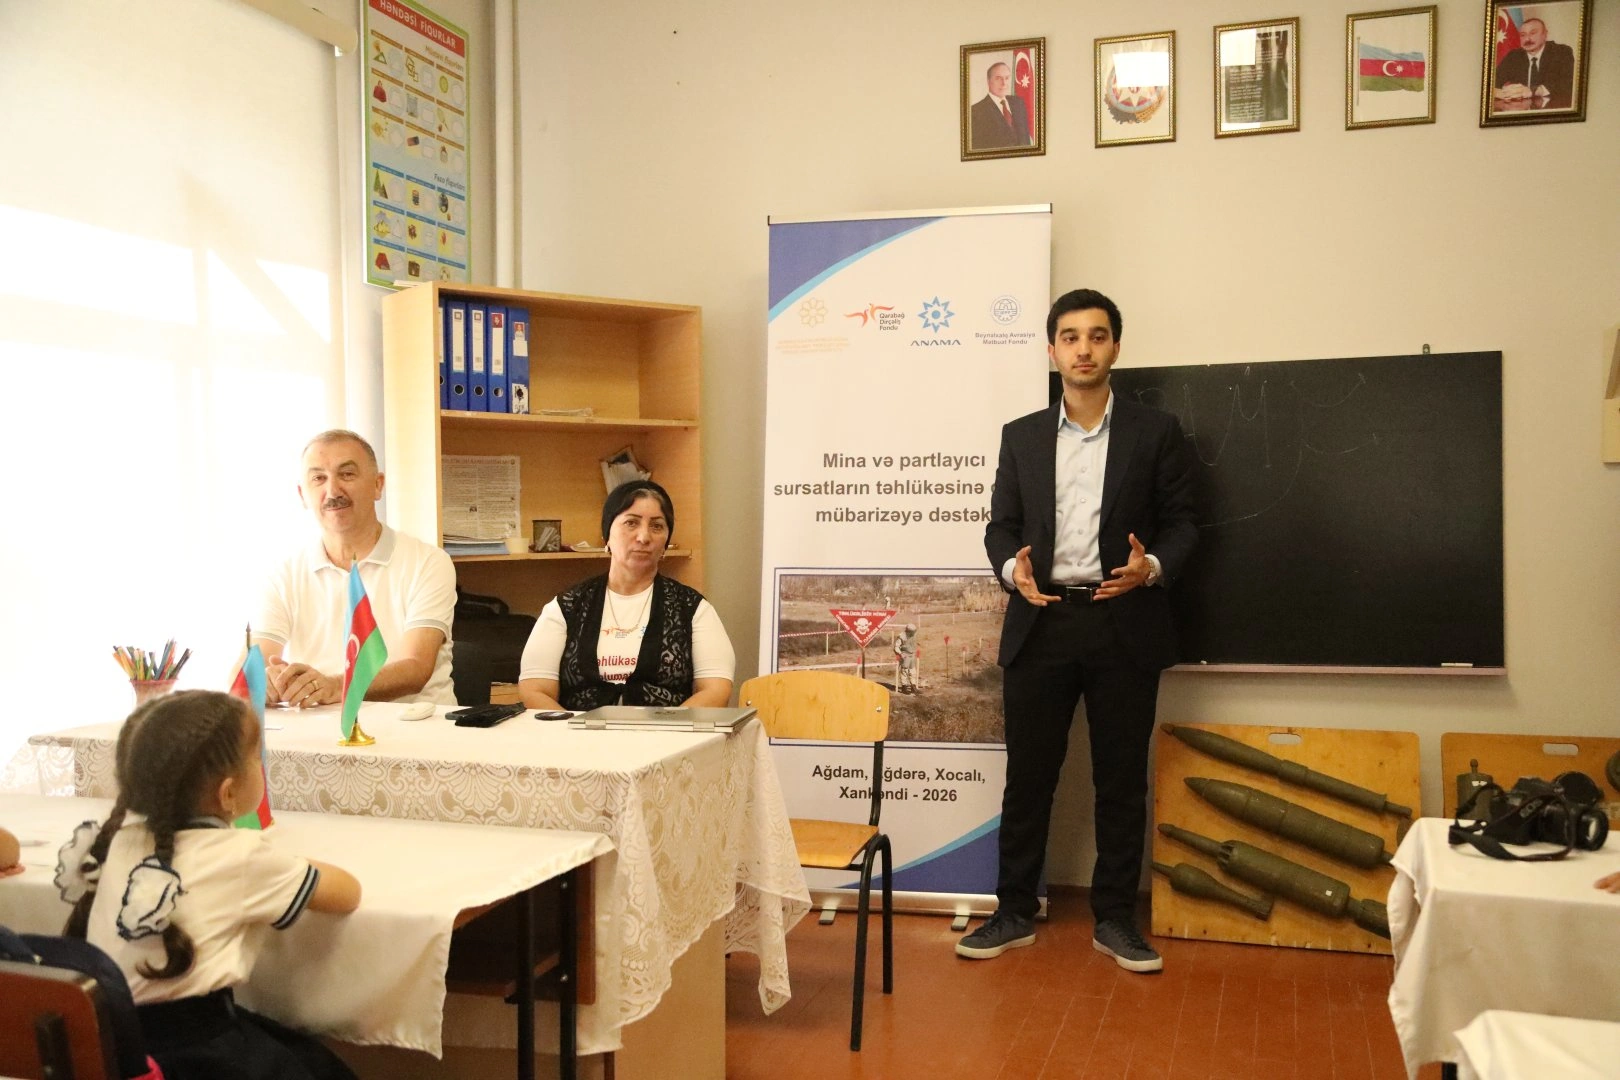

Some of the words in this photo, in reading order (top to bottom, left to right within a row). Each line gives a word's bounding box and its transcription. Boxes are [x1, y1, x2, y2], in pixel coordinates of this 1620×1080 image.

[911, 339, 961, 347] ANAMA
[823, 453, 867, 468] Mina
[872, 456, 894, 468] və
[900, 452, 986, 471] partlayıcı
[774, 480, 870, 496] sursatların
[876, 480, 985, 495] təhlükəsinə
[815, 507, 923, 526] mübarizəyə
[928, 507, 991, 522] dəstək
[812, 765, 869, 781] Ağdam,
[881, 766, 930, 782] ğdərə,
[935, 768, 986, 784] Xocalı,
[922, 789, 958, 802] 2026
